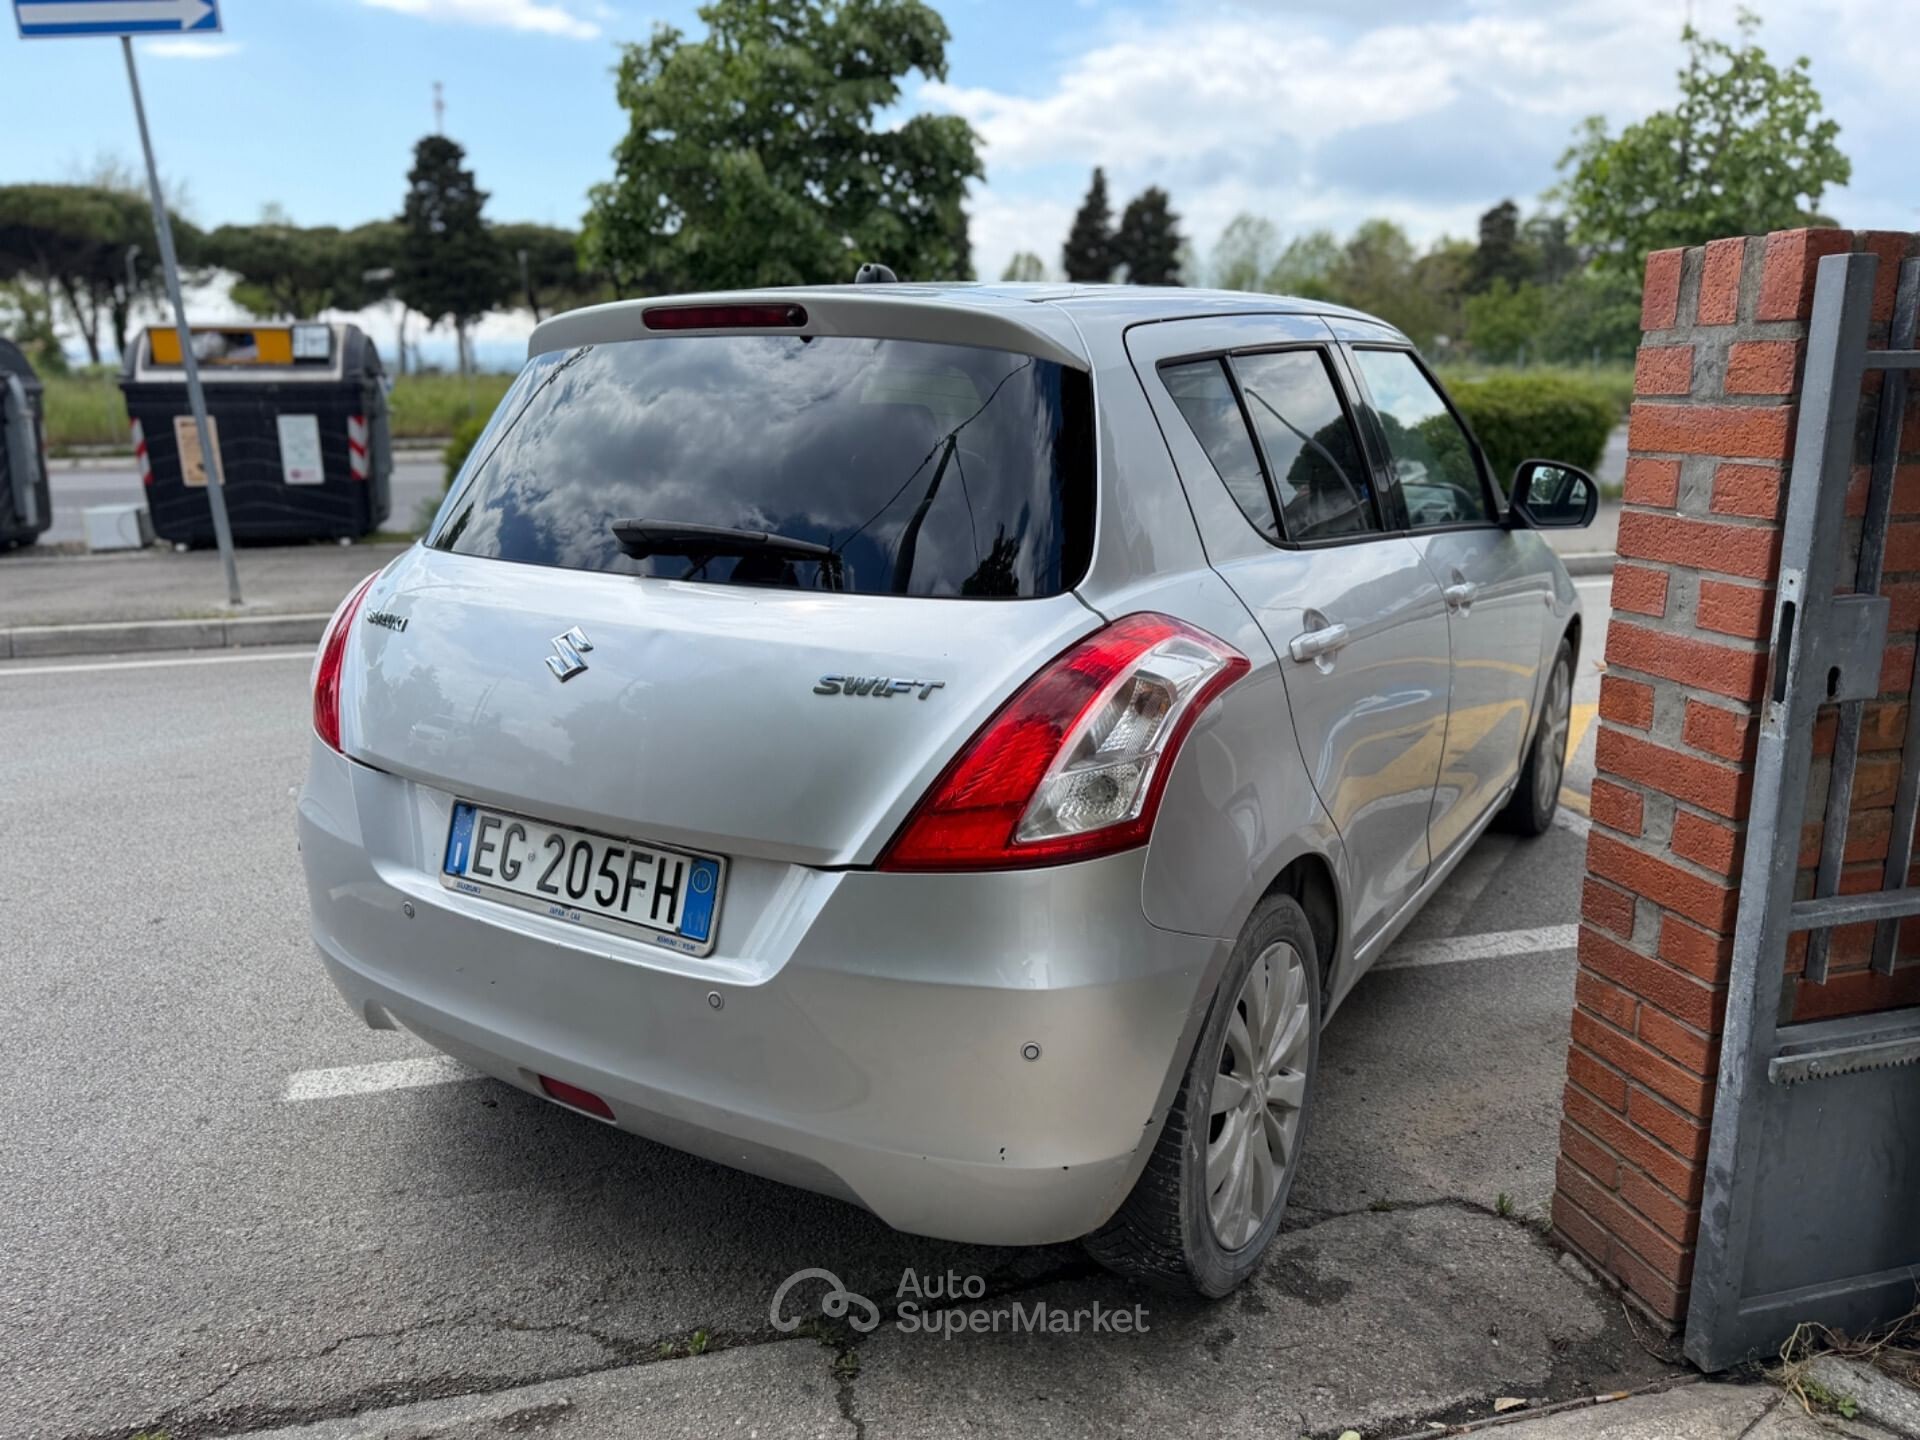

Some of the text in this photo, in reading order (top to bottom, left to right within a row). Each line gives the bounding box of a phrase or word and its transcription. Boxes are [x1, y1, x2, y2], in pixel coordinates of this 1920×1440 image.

[812, 672, 946, 701] SWIFT
[471, 814, 684, 924] EG 205FH
